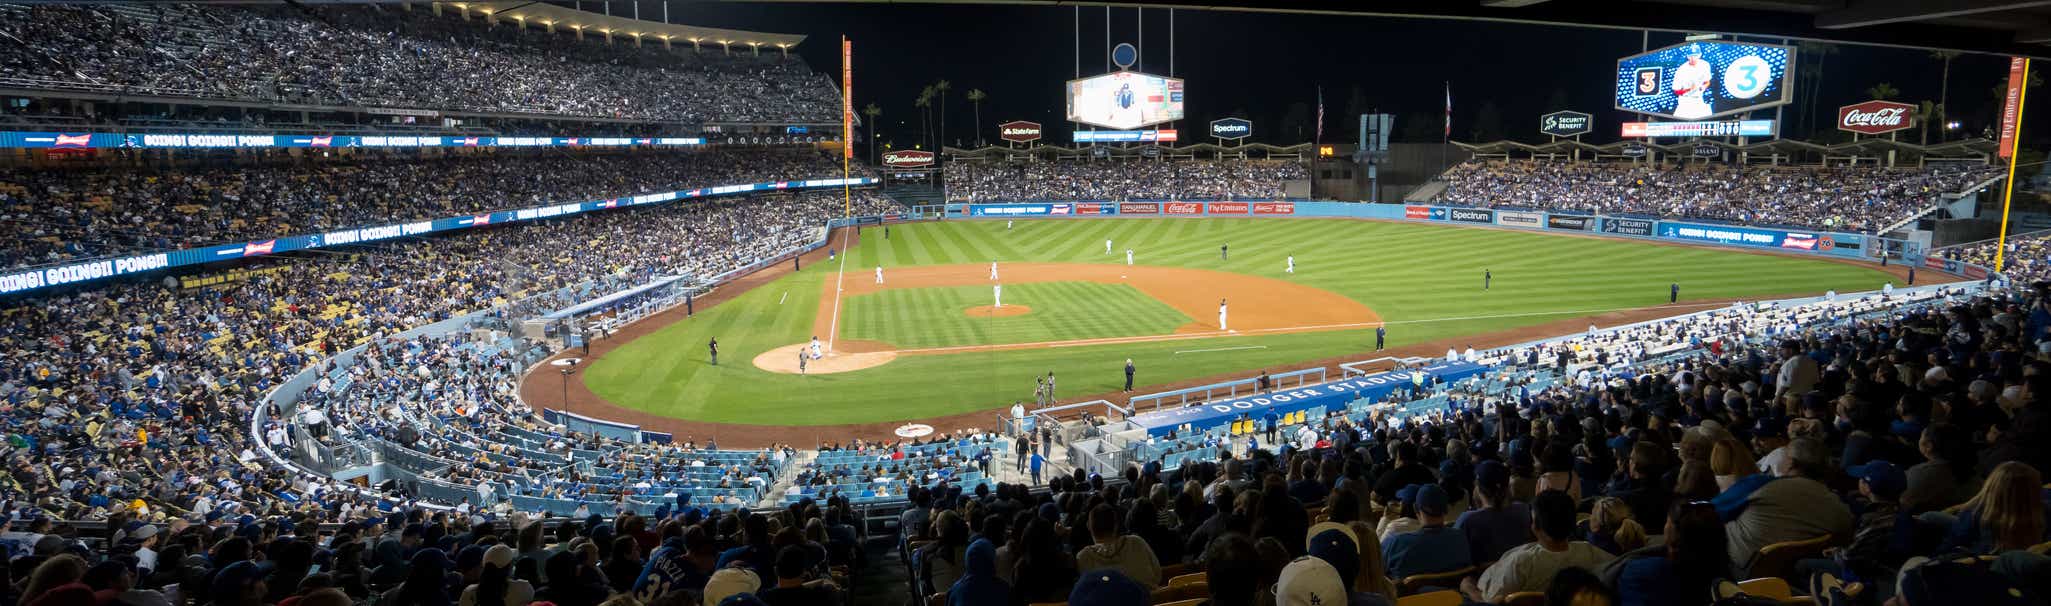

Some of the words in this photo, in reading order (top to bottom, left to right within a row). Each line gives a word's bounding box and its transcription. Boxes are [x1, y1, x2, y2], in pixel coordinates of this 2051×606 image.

[1640, 72, 1655, 92] 3
[1737, 65, 1758, 91] 3
[1843, 108, 1906, 126] Coca-Cola
[1214, 125, 1246, 133] Spectrum
[884, 154, 932, 163] Budweiser
[1168, 203, 1197, 213] Coca-Cola
[1453, 210, 1489, 222] Spectrum
[1619, 217, 1649, 228] SECURITY
[1617, 225, 1646, 235] BENEFIT
[1211, 388, 1324, 414] DODGER
[655, 556, 686, 583] PIAZZA
